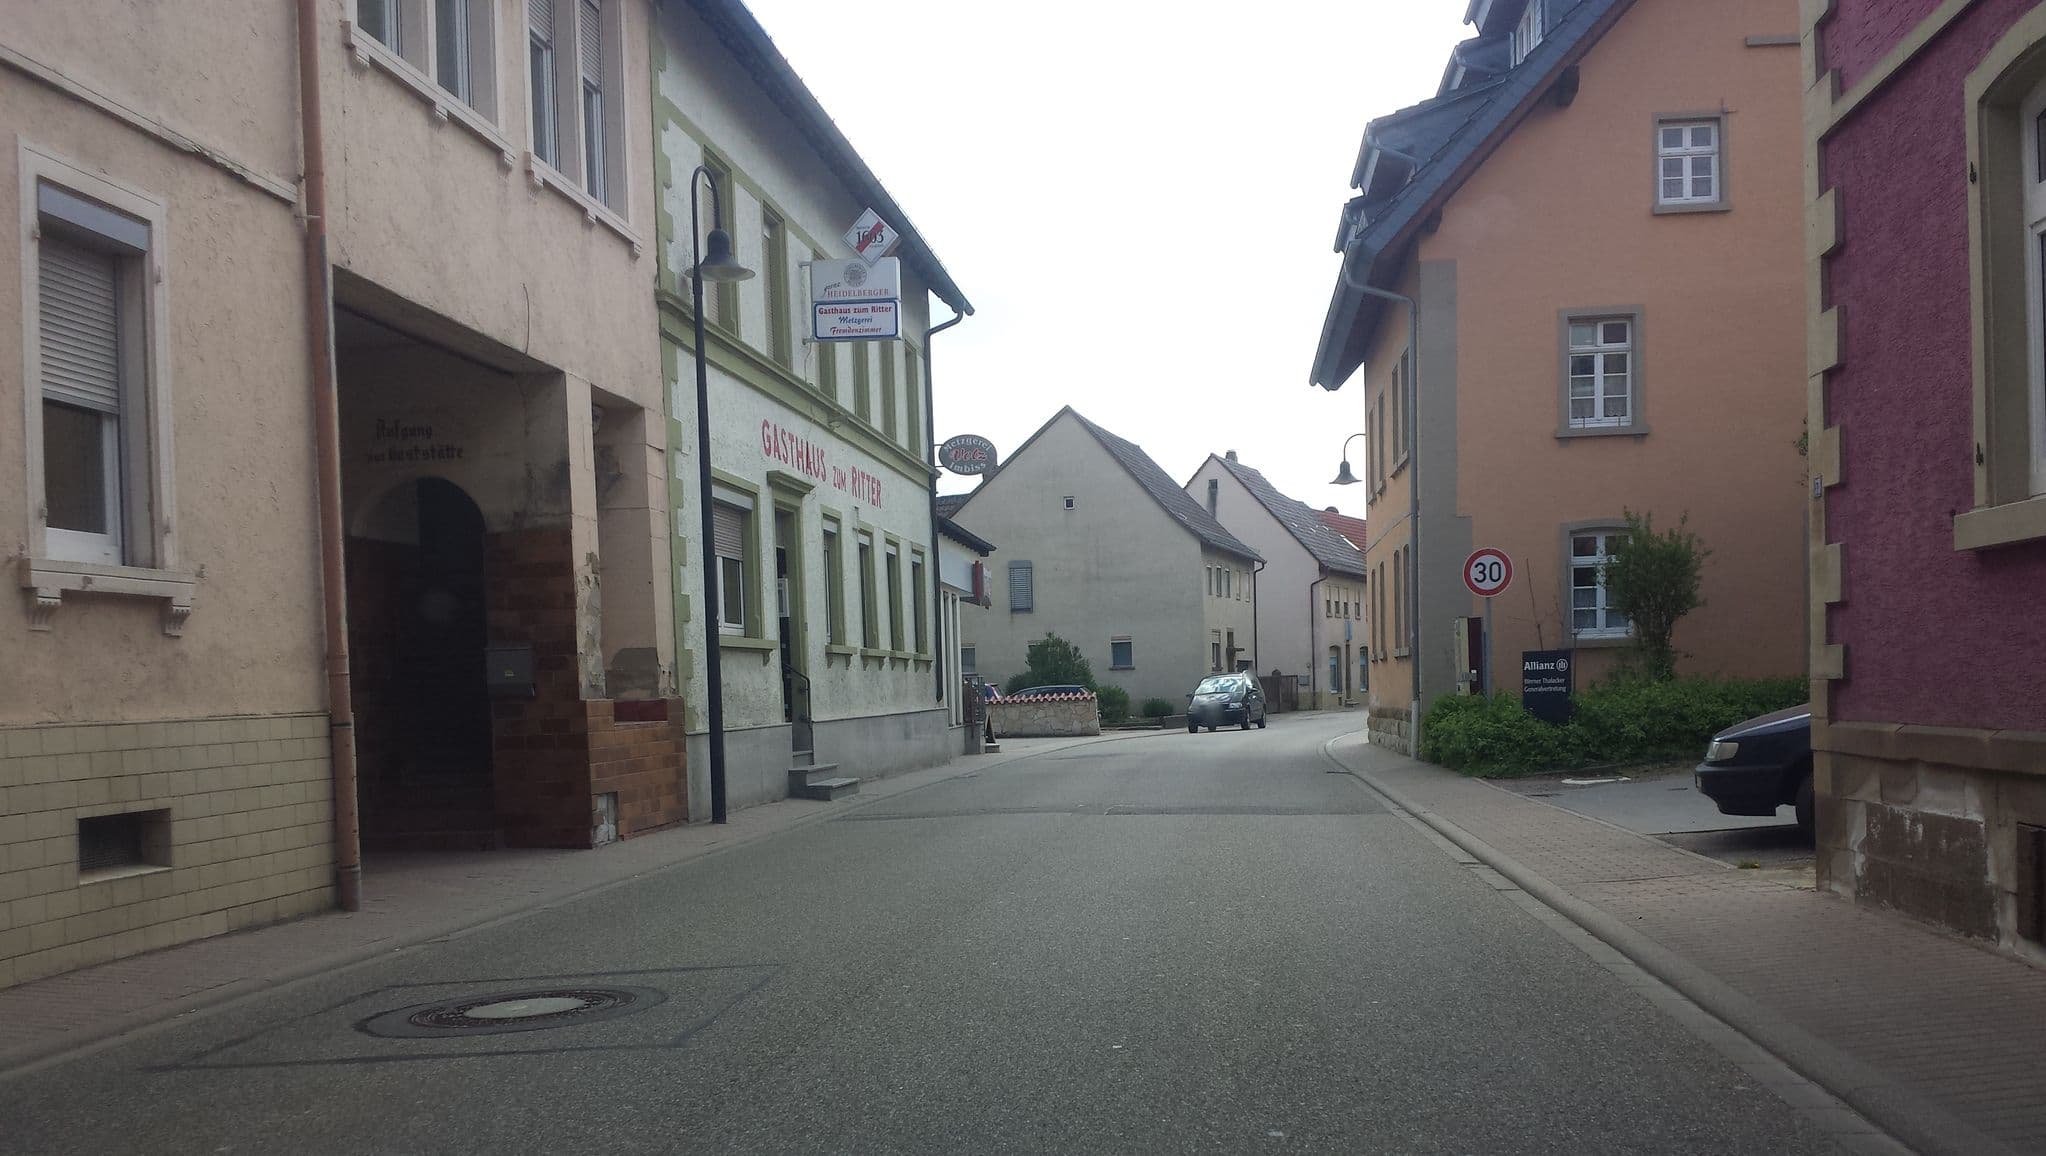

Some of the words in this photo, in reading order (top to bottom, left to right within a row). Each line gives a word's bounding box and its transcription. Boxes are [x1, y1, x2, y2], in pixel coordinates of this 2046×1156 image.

[856, 230, 884, 245] 1603
[827, 288, 889, 298] HEIDELBERGER
[818, 306, 851, 315] Gasthaus
[871, 305, 892, 314] Ritter
[838, 316, 873, 326] Metzgerei
[830, 325, 882, 336] Fremdenzimmer
[943, 438, 992, 452] Metzgerei
[762, 419, 827, 482] GASTHAUS
[833, 466, 847, 492] ZUM
[851, 465, 881, 509] RITTER
[1474, 561, 1502, 583] 30
[1523, 661, 1555, 671] Allianz
